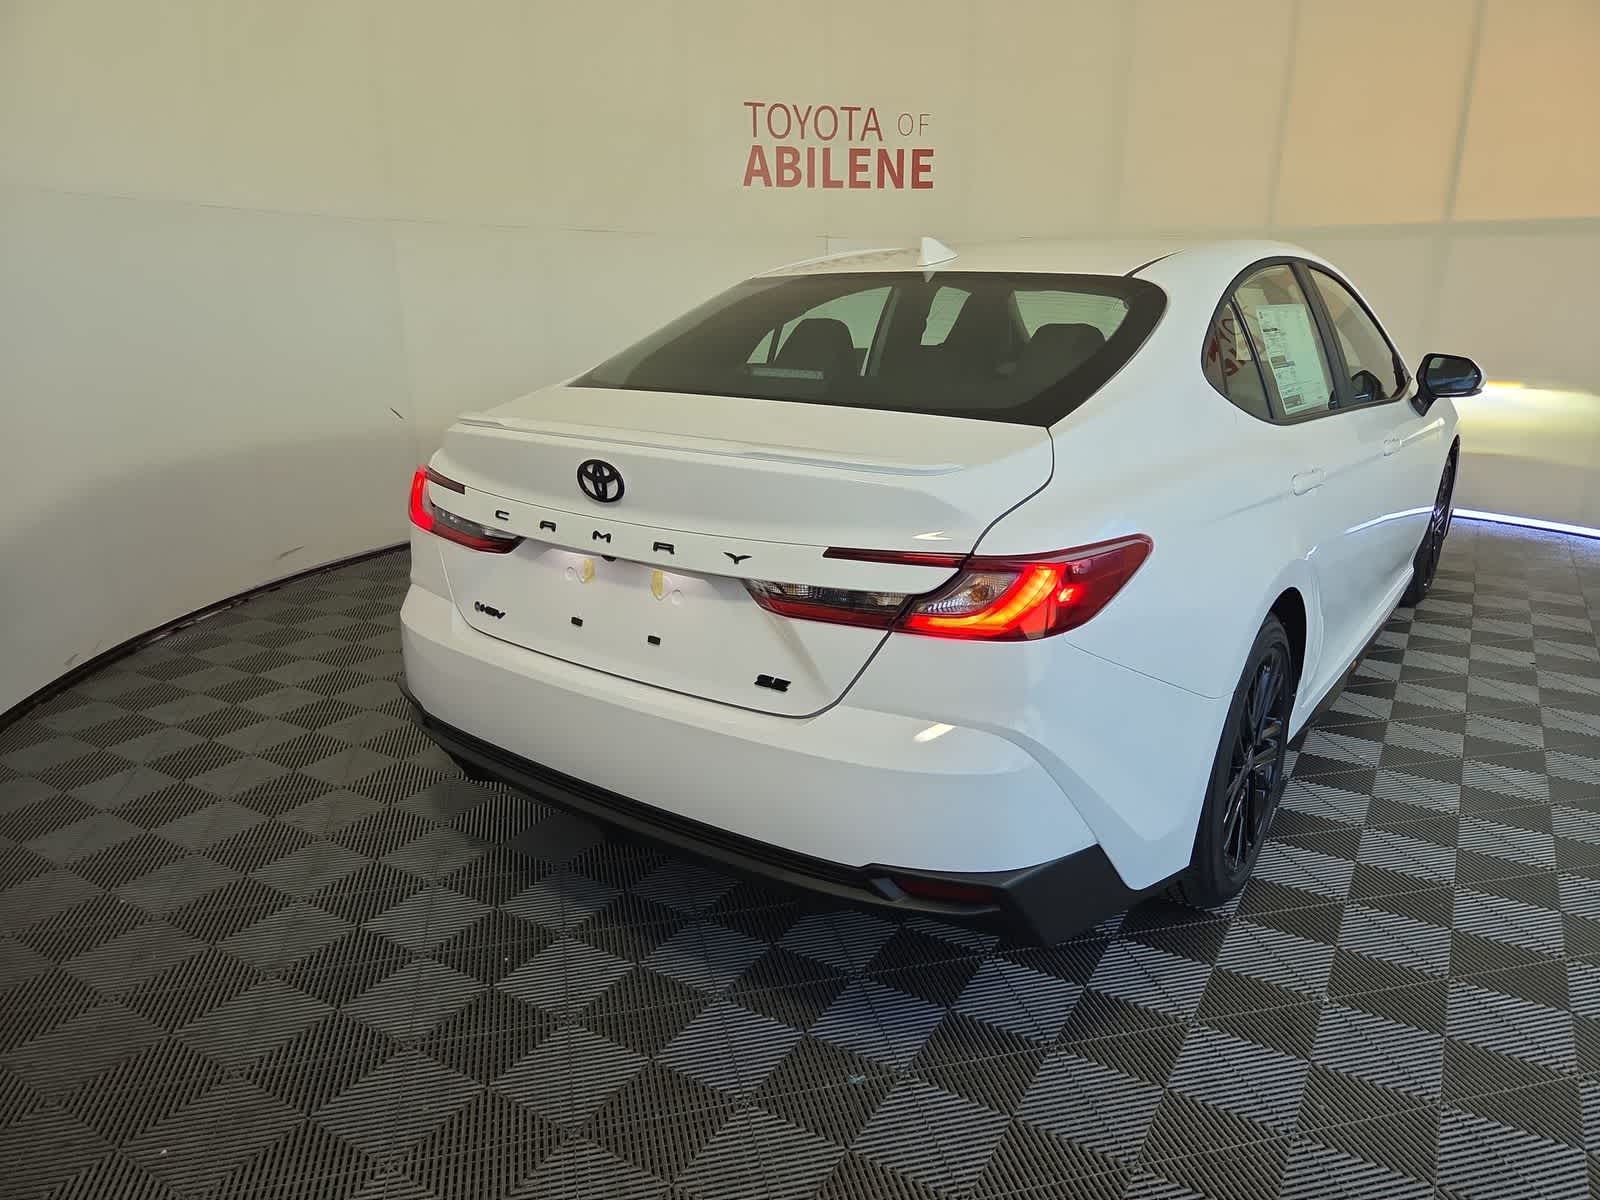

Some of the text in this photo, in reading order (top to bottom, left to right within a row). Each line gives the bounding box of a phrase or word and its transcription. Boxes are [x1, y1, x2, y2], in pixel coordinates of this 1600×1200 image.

[743, 101, 931, 142] TOYOTA OF
[743, 144, 934, 189] ABILENE
[495, 509, 752, 565] CAMRY
[754, 674, 791, 692] SE
